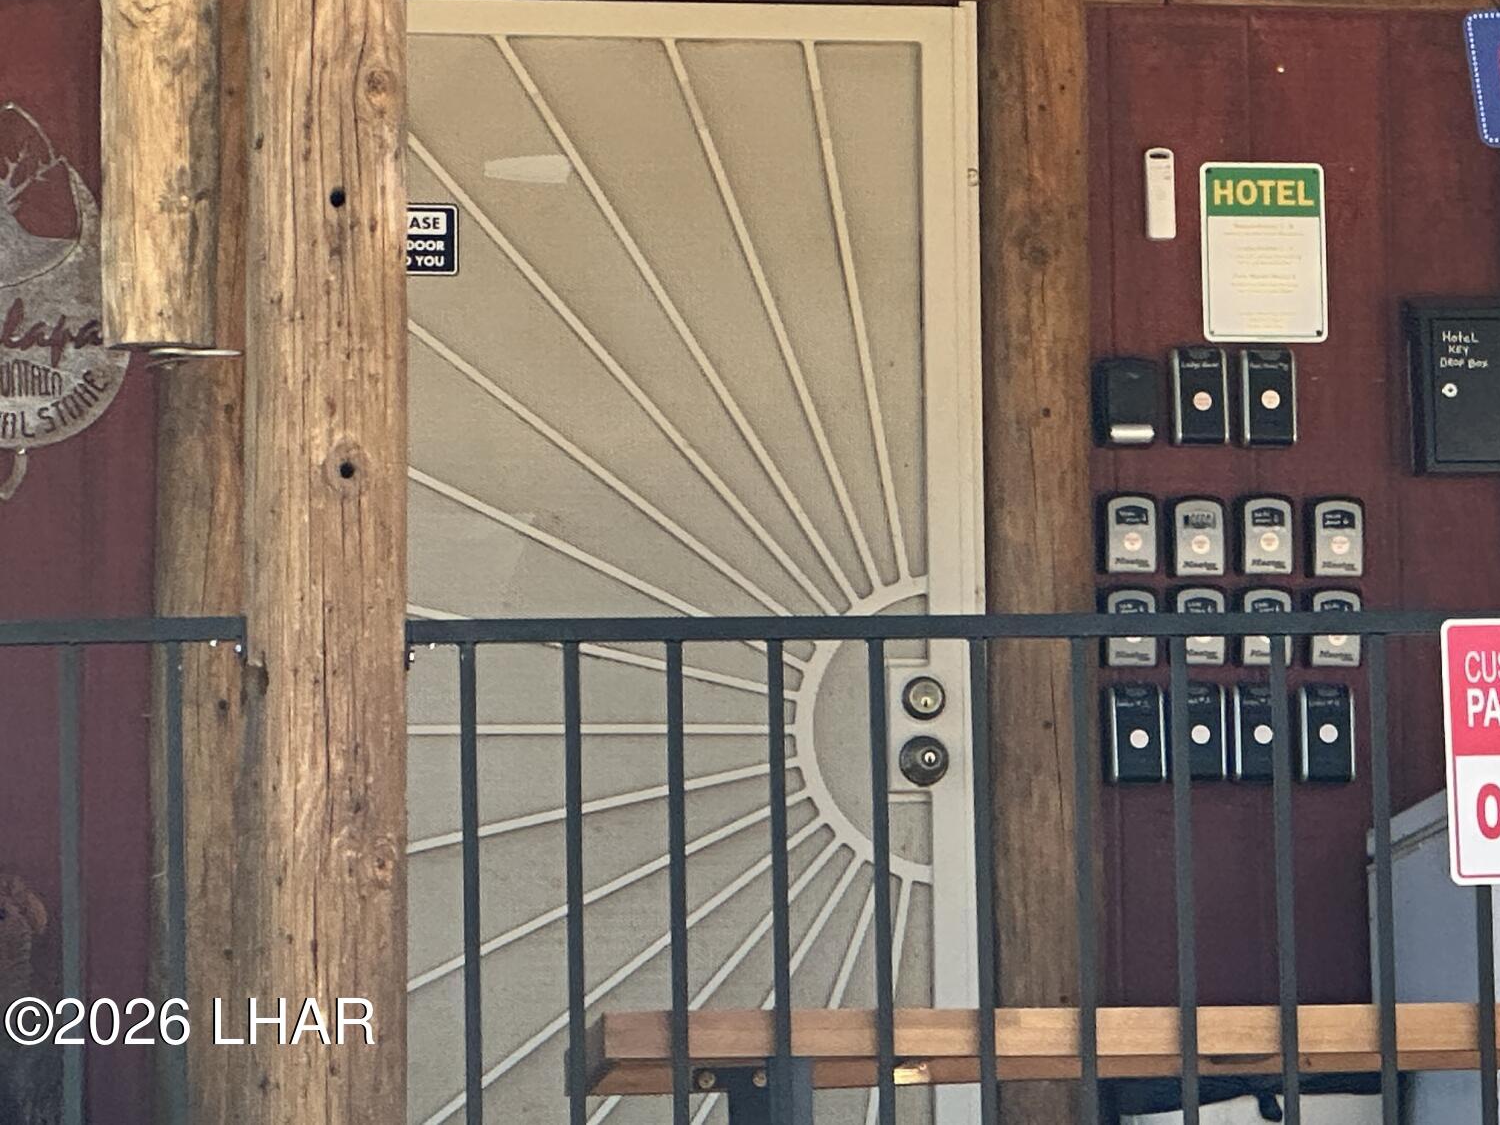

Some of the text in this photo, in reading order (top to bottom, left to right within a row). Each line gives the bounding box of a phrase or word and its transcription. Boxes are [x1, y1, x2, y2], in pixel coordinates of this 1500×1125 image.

[1213, 178, 1315, 207] HOTEL
[409, 217, 440, 229] ASE
[406, 240, 445, 251] DOOR
[415, 256, 445, 267] YOU
[0, 297, 103, 368] lapa
[0, 359, 62, 397] UNTAIN
